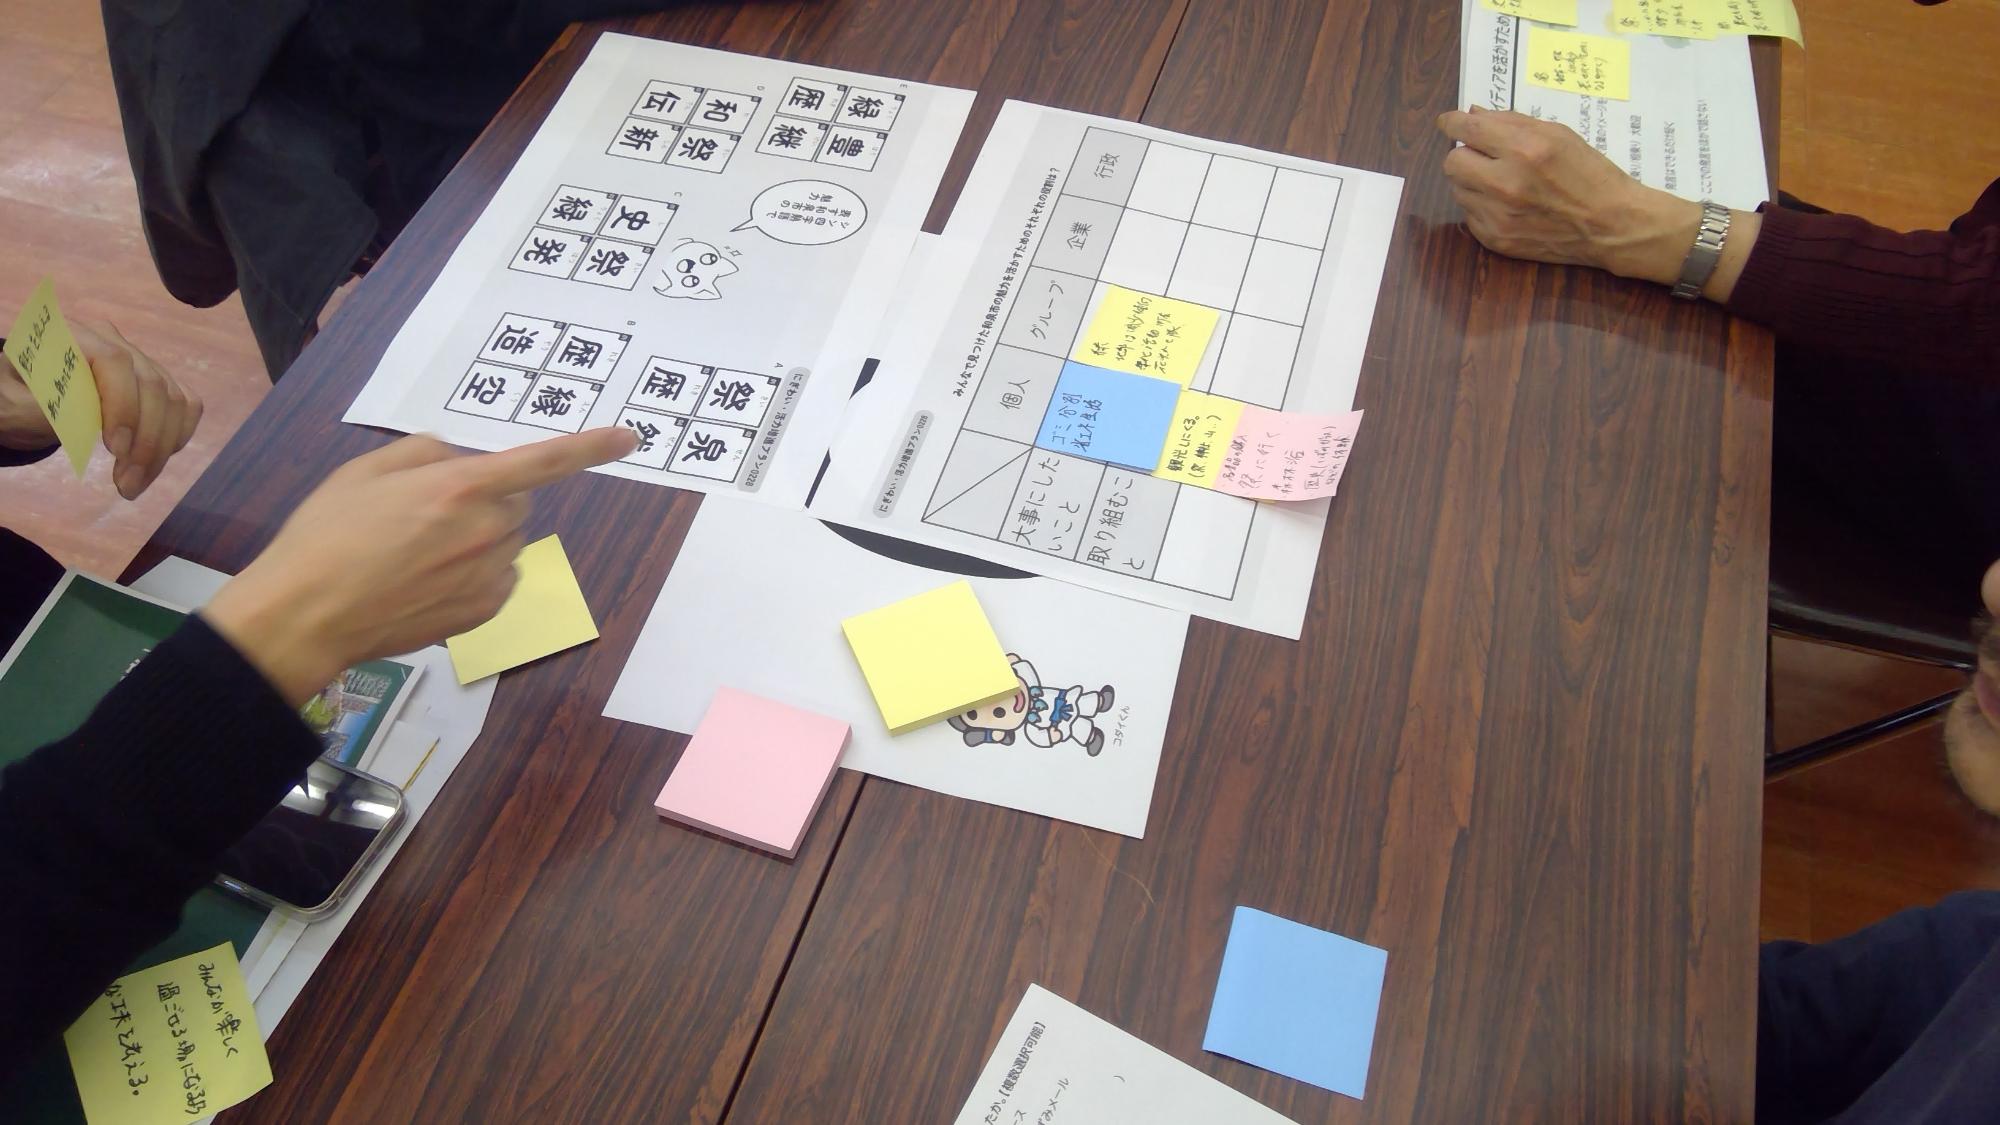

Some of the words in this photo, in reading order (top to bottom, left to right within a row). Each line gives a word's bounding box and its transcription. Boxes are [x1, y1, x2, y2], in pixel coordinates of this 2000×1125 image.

[641, 90, 681, 113] 伝
[703, 98, 738, 123] 和
[787, 84, 826, 111] 歴
[847, 95, 884, 119] 緑
[618, 125, 660, 152] 新
[677, 136, 719, 162] 祭
[767, 123, 808, 150] 継
[826, 133, 865, 158] 豊
[1093, 152, 1121, 179] 行政
[551, 195, 594, 222] 緑
[610, 205, 651, 231] 史
[523, 236, 567, 266] 発
[1066, 221, 1093, 251] 企業
[585, 248, 630, 277] 祭
[1029, 279, 1064, 340] グループ
[491, 324, 540, 355] 造
[557, 335, 603, 370] 歴
[460, 372, 506, 405] 空
[641, 366, 687, 402] 歴
[708, 380, 756, 412] 祭
[999, 379, 1031, 410] 個人
[681, 431, 728, 462] 泉
[1011, 457, 1061, 546] 大事にした
[1047, 501, 1081, 552] いこと
[1086, 476, 1134, 566] 取り組むこ
[1121, 557, 1145, 571] と
[1113, 705, 1130, 747] コダイくん
[198, 963, 241, 1058] みんなが楽しく
